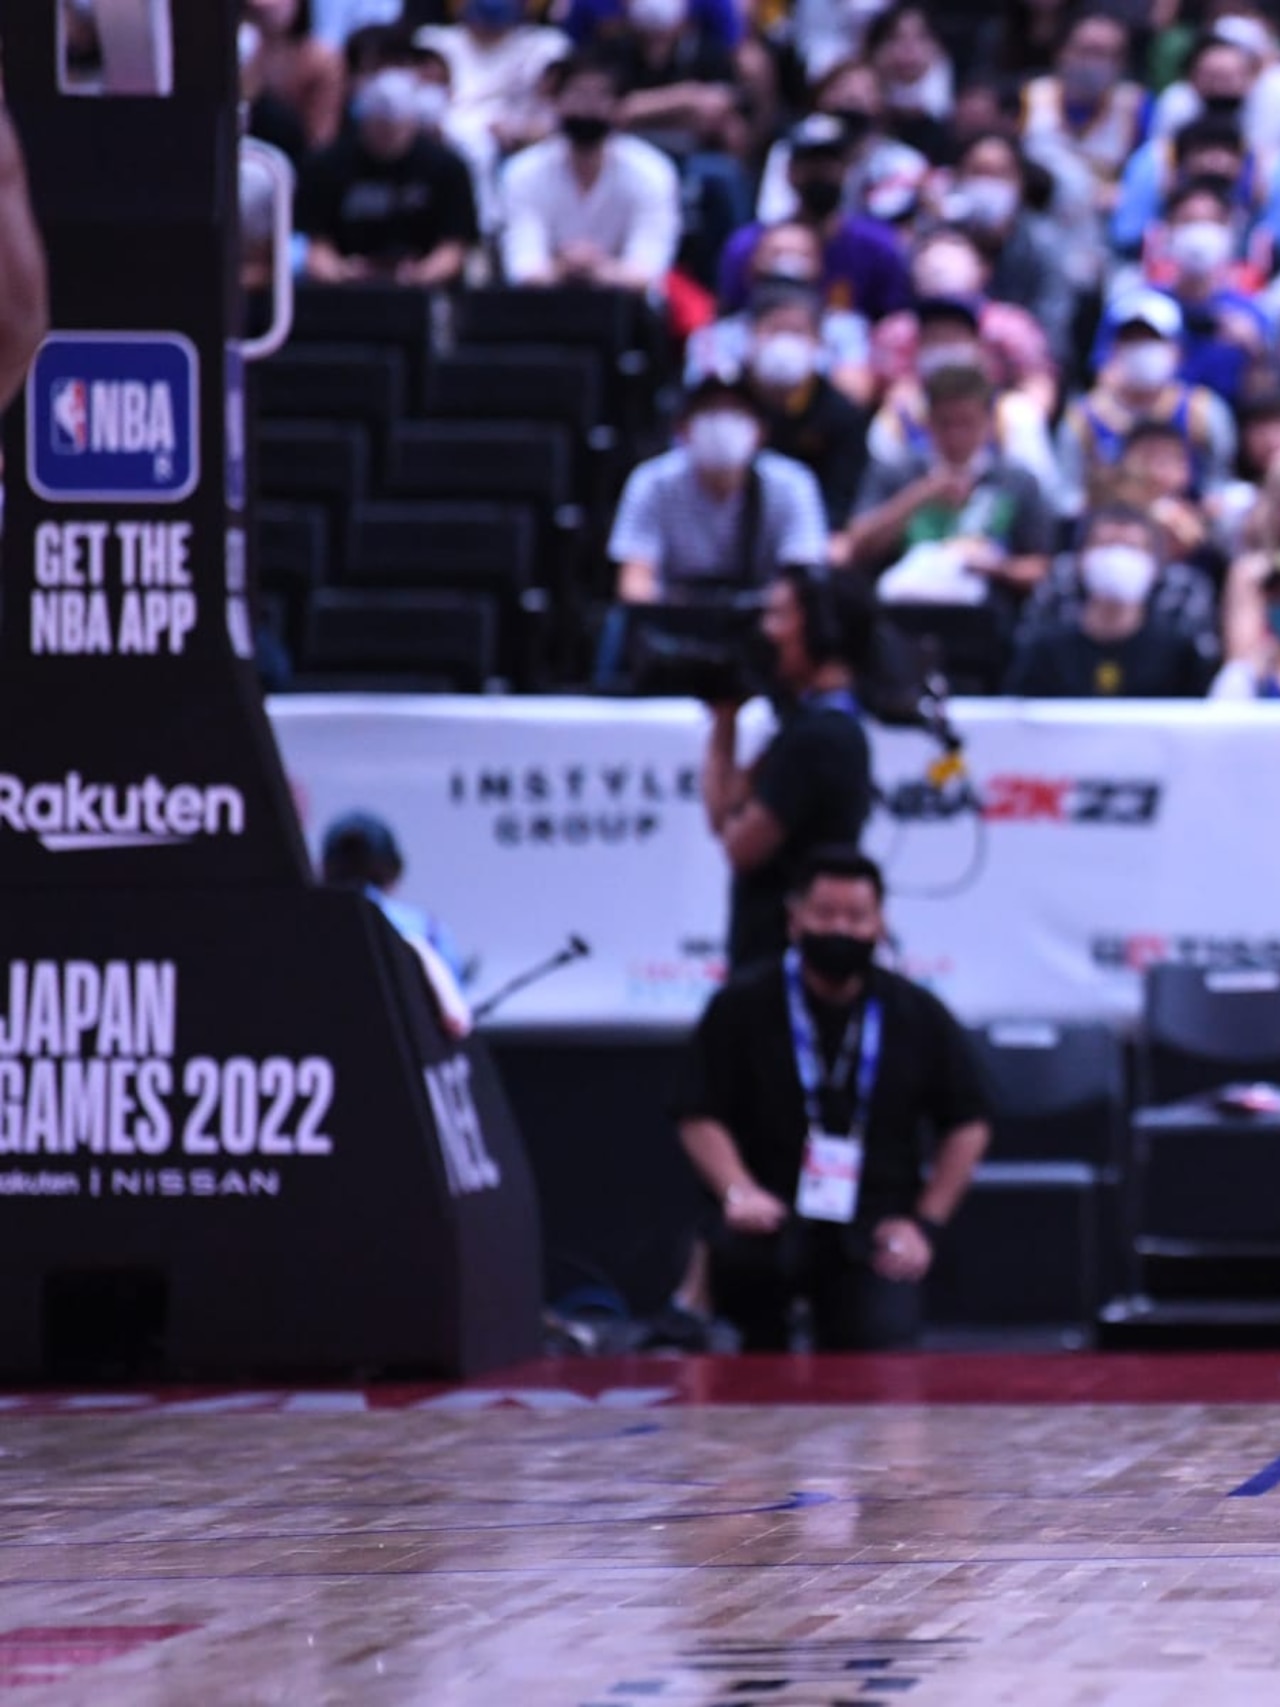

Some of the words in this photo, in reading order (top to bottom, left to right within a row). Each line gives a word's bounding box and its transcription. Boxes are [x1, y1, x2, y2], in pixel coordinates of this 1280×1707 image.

[90, 380, 176, 453] NBA
[35, 521, 109, 588] GET
[115, 521, 193, 588] THE
[31, 588, 112, 655] NBA
[117, 588, 197, 655] APP
[0, 770, 246, 838] Rakuten
[493, 811, 659, 847] GROUP
[0, 959, 176, 1057] JAPAN
[0, 1057, 173, 1154] GAMES
[183, 1056, 335, 1154] 2022
[111, 1168, 279, 1196] NISSAN
